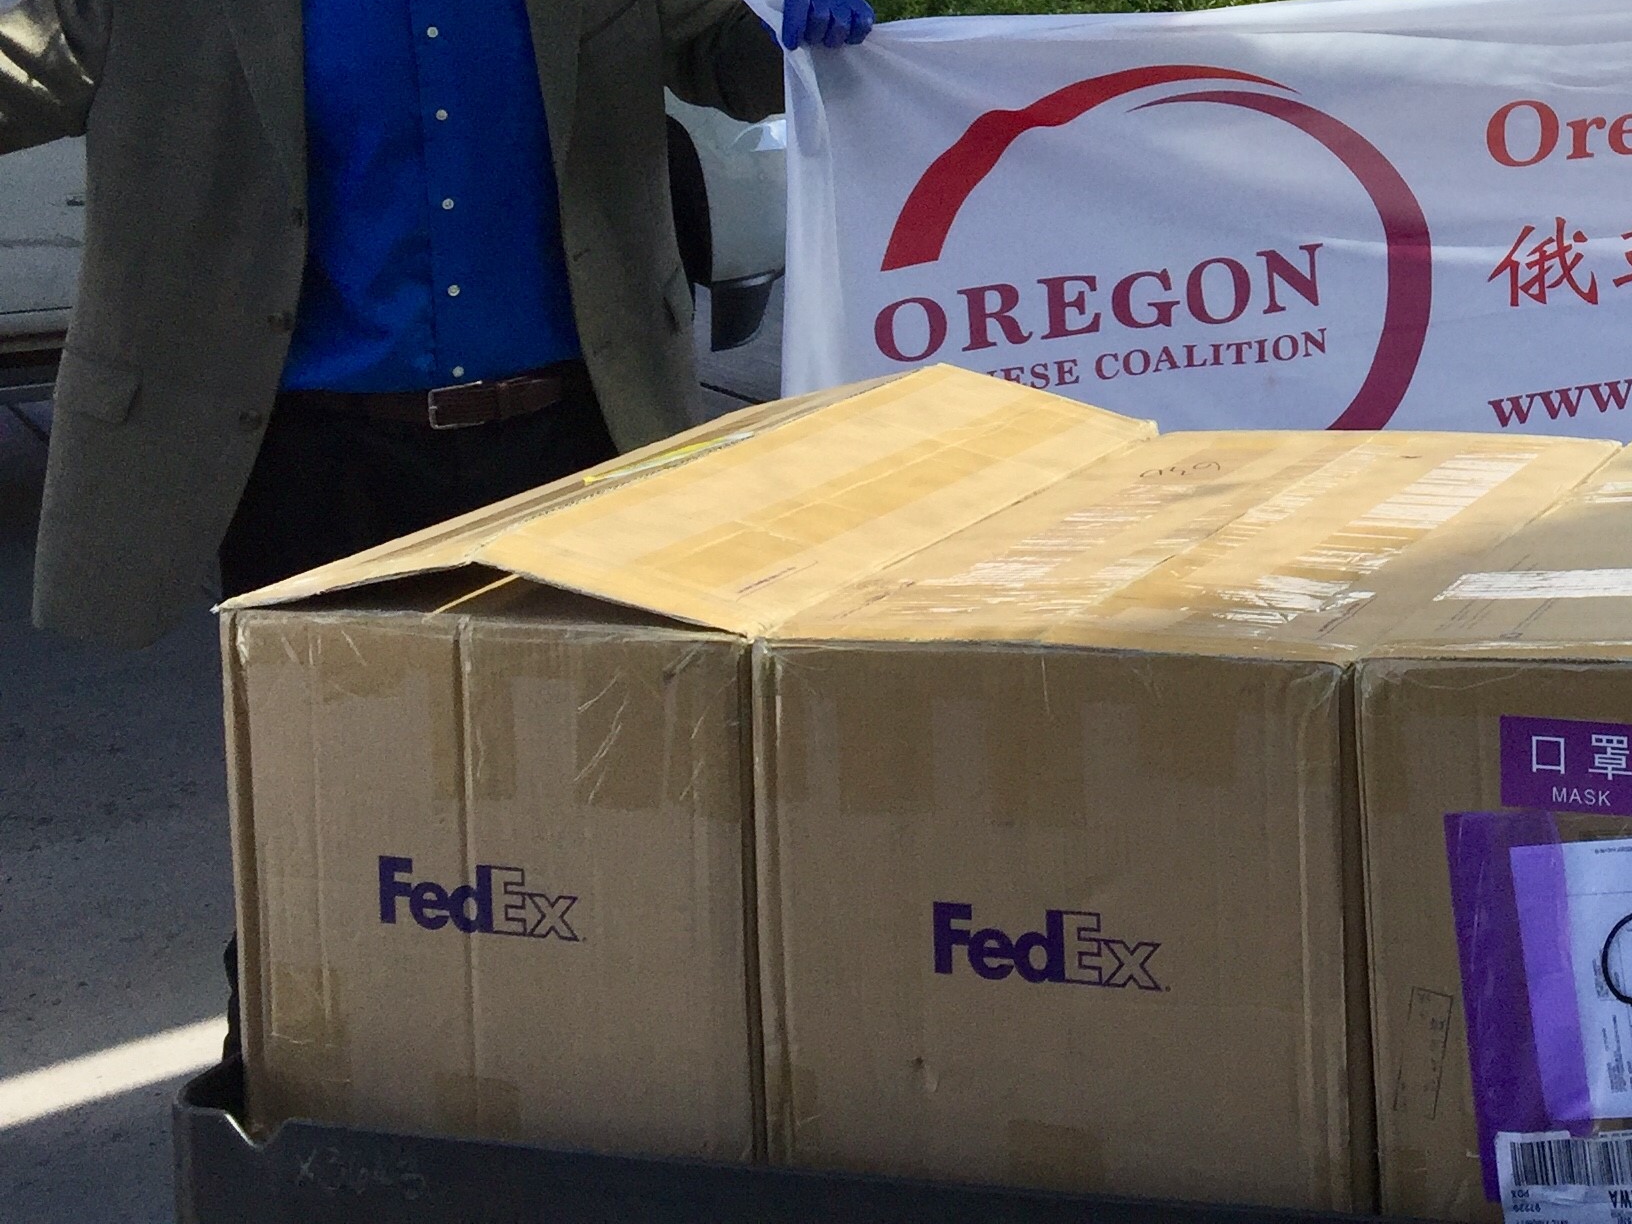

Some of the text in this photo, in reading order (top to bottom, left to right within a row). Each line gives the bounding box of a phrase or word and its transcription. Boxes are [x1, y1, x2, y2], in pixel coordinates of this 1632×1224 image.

[873, 243, 1323, 363] OREGON
[1094, 327, 1327, 381] COALITION
[1531, 733, 1632, 781] 口罩
[1552, 786, 1611, 807] MASK
[378, 855, 580, 942] FedEx
[932, 900, 1163, 992] FedEx
